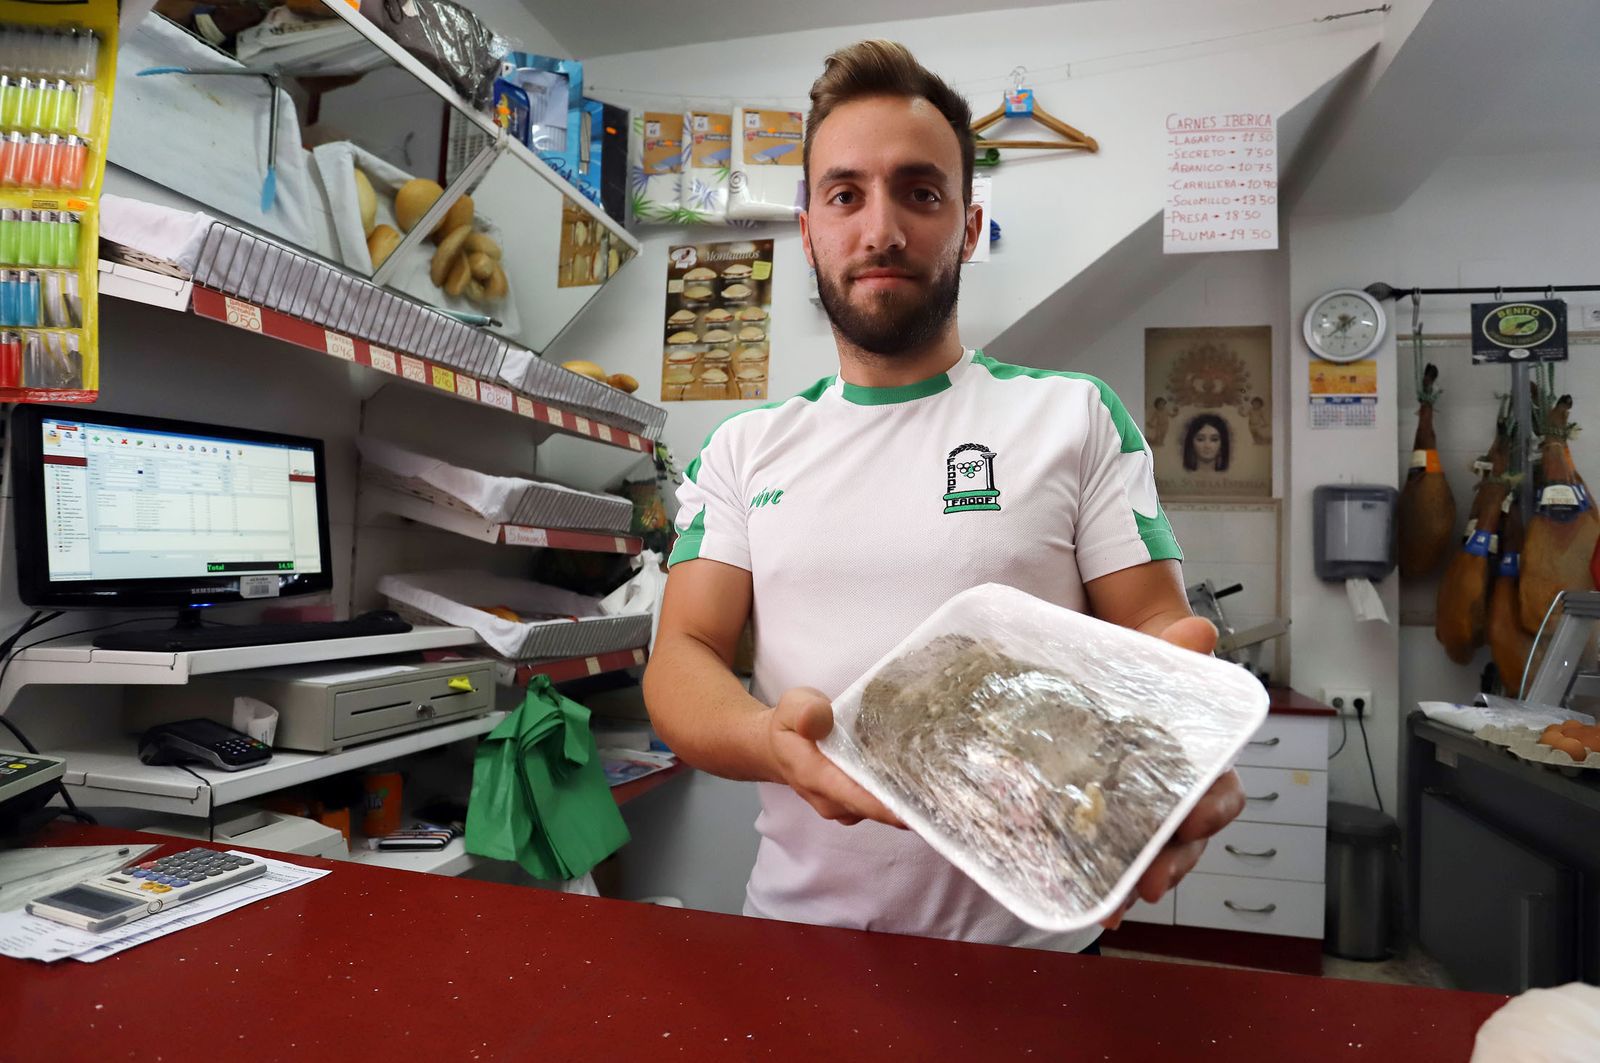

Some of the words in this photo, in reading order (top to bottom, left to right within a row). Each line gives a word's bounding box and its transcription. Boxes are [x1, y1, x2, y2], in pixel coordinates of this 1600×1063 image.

[1166, 113, 1217, 130] CARNES
[1223, 113, 1272, 128] IBERICA
[1497, 307, 1540, 318] BENITO
